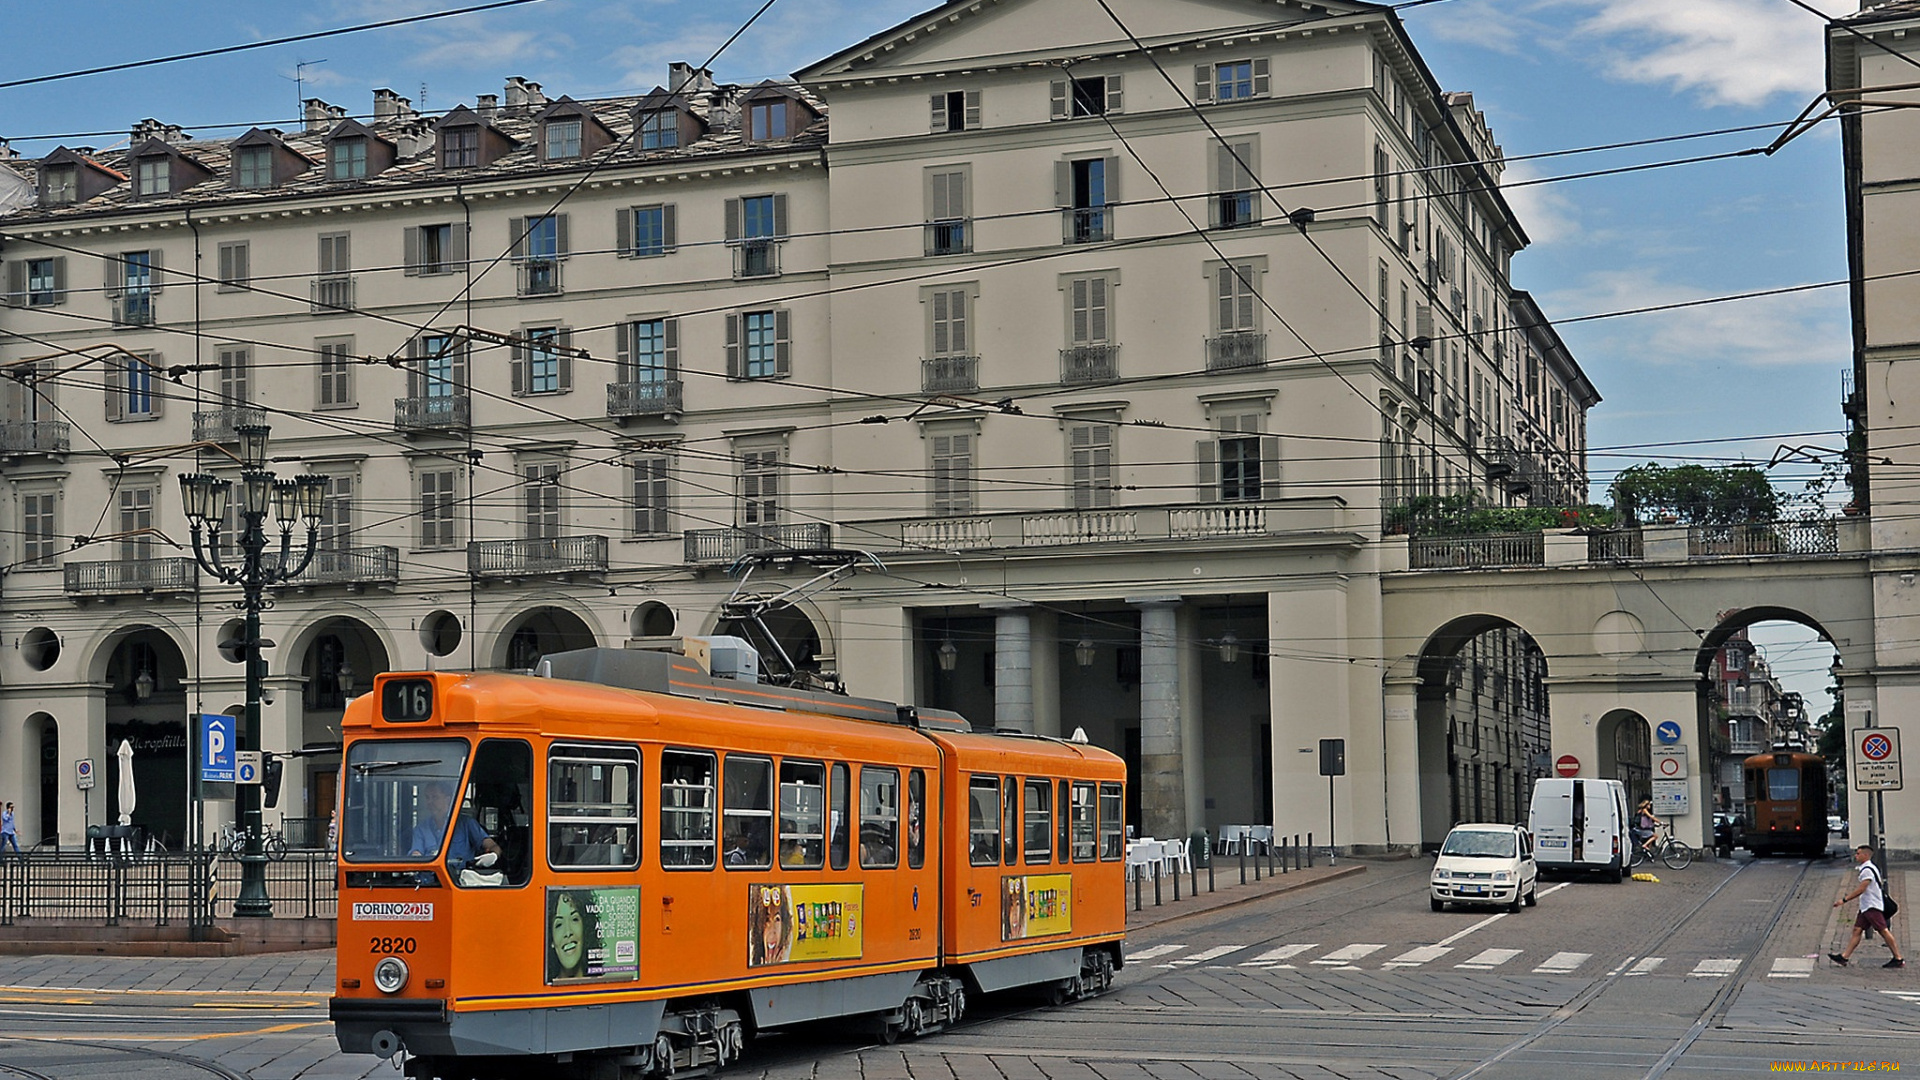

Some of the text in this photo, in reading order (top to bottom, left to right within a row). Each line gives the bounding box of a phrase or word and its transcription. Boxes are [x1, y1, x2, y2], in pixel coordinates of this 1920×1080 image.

[398, 685, 427, 717] 16
[208, 730, 225, 766] P
[585, 904, 605, 914] VADO
[370, 937, 417, 954] 2820
